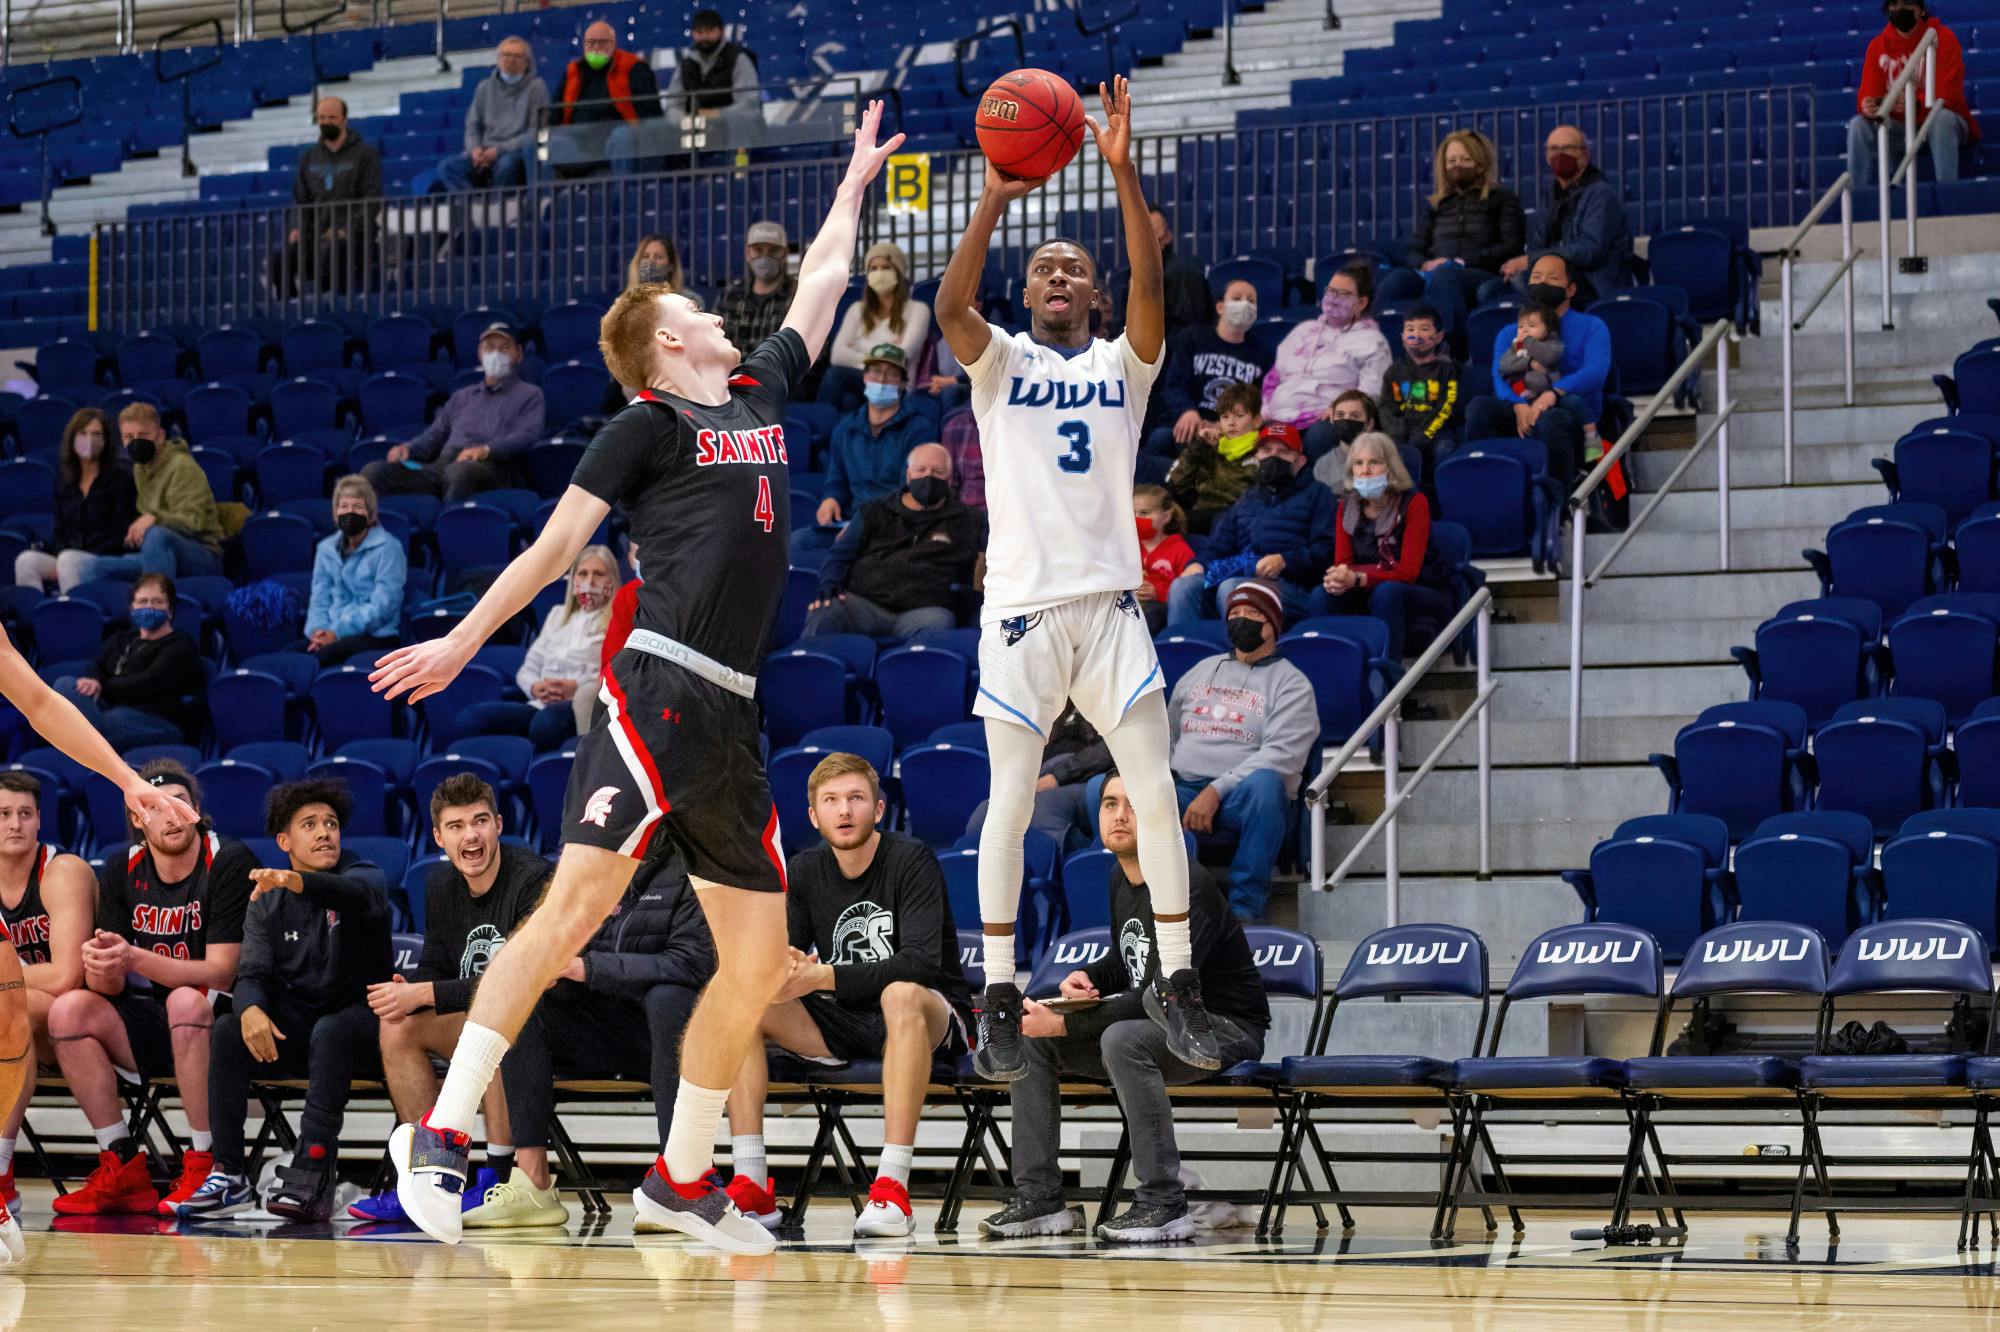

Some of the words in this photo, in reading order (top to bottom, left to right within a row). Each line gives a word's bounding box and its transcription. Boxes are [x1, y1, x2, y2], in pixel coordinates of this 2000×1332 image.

[894, 164, 922, 202] B
[1008, 376, 1125, 410] WWU
[696, 424, 788, 466] SAINTS
[1057, 419, 1092, 474] 3
[754, 475, 774, 532] 4
[1366, 941, 1469, 965] WWU
[1536, 940, 1643, 964] WWU
[1703, 938, 1811, 963] WWU
[1857, 937, 1970, 961] WWU
